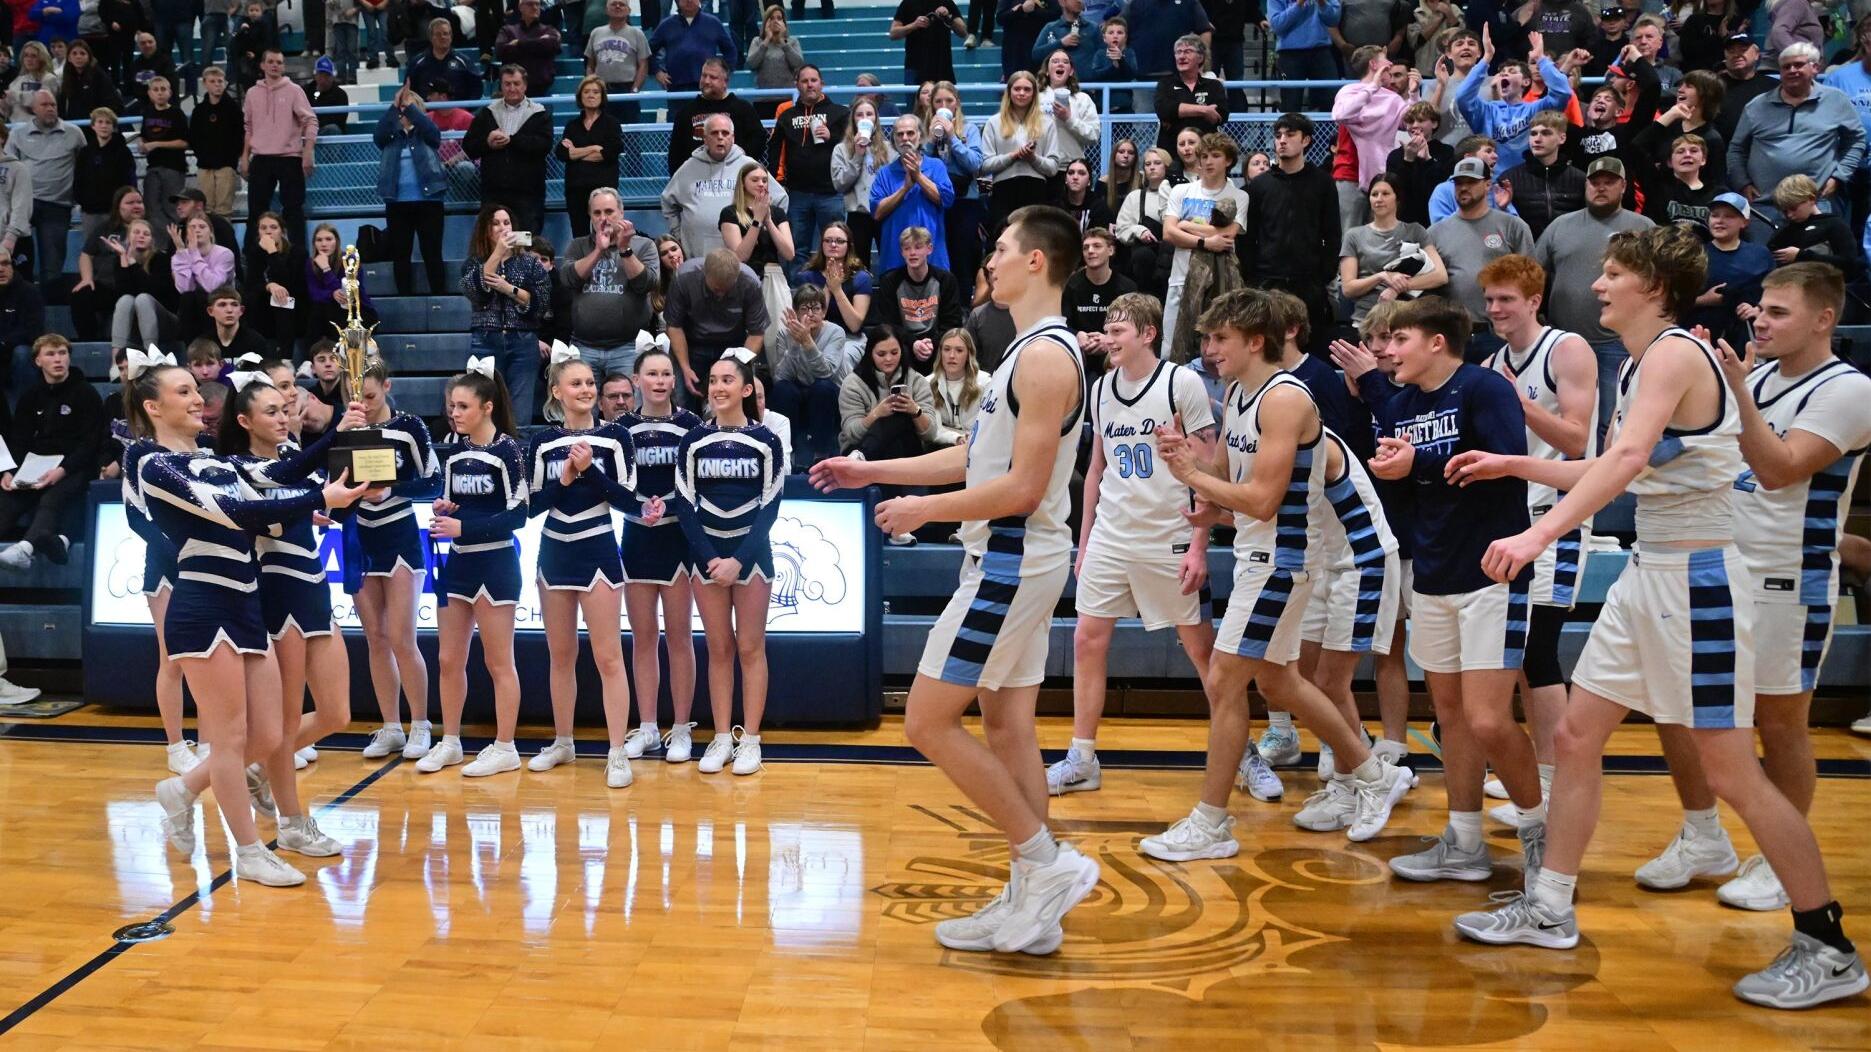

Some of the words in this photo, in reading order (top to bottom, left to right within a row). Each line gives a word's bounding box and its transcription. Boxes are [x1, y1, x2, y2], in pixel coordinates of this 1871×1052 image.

[696, 178, 724, 193] MATER
[584, 283, 625, 295] CATHOLIC
[1103, 420, 1137, 439] Mater
[698, 458, 760, 479] KNIGHTS
[1113, 443, 1153, 479] 30
